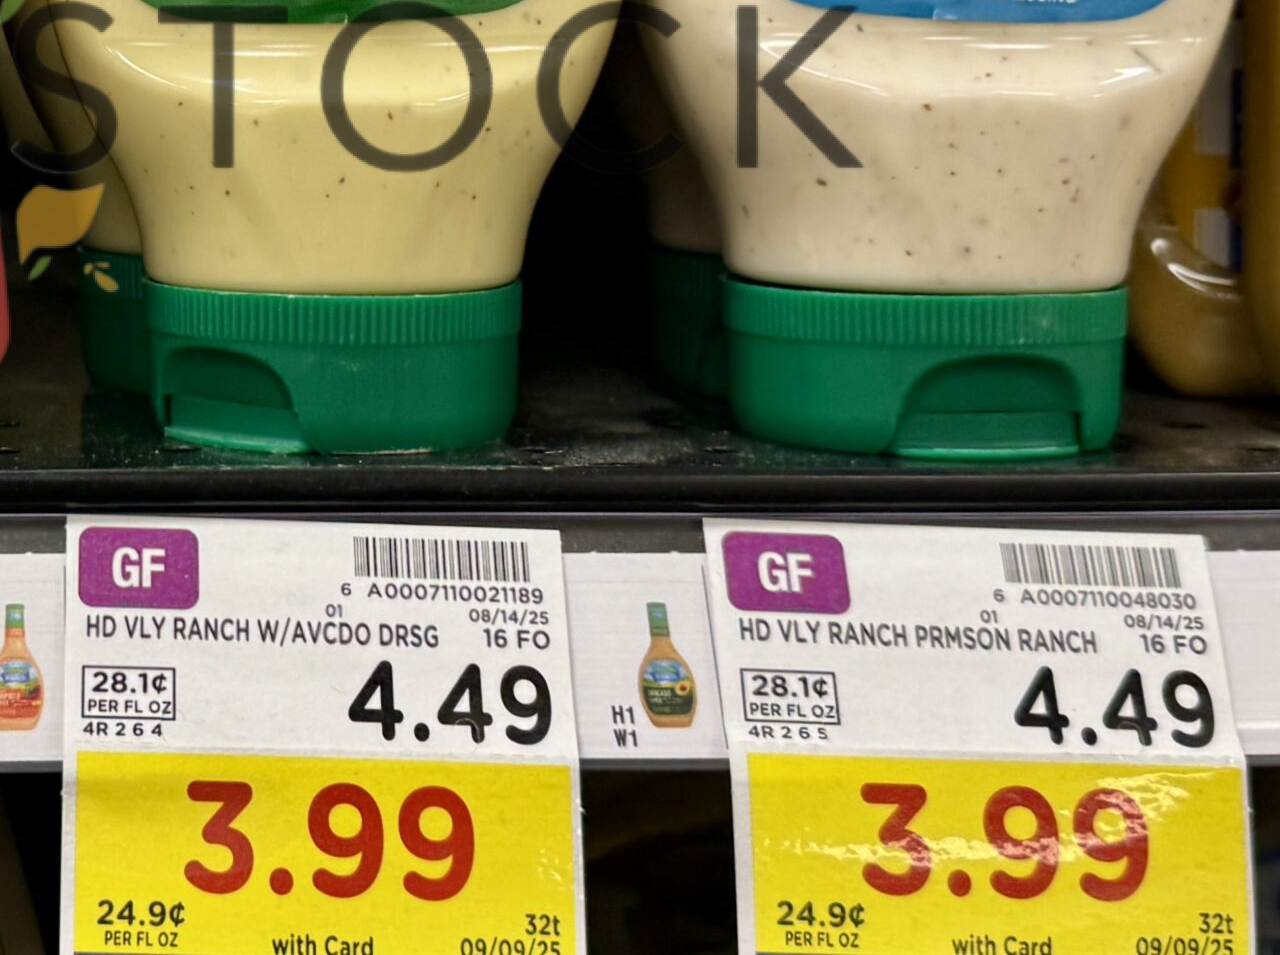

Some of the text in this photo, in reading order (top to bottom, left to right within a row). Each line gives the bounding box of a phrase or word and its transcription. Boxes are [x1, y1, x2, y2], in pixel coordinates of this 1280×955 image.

[112, 548, 166, 588] GF
[758, 552, 815, 593] GF
[367, 584, 543, 605] A0007110021189
[1021, 589, 1197, 611] A0007110048030
[469, 608, 549, 625] 08/14/25
[1123, 614, 1204, 631] 08/14/25
[85, 615, 551, 650] HD VLY RANCH W/AVCDO DRSG 16 FO
[739, 618, 1207, 655] HD VLY RANCH PRMSON RANCH 16 FO
[91, 671, 167, 695] 28.1¢
[751, 675, 828, 698] 28.1¢
[348, 660, 552, 745] 4.49
[1014, 666, 1215, 748] 4.49
[611, 706, 634, 724] H1
[613, 730, 638, 747] W1
[183, 780, 475, 902] 3.99
[860, 783, 1149, 902] 3.99
[96, 902, 185, 927] 24.9¢
[525, 915, 560, 936] 32t
[776, 902, 865, 928] 24.9¢
[1199, 913, 1234, 934] 32t
